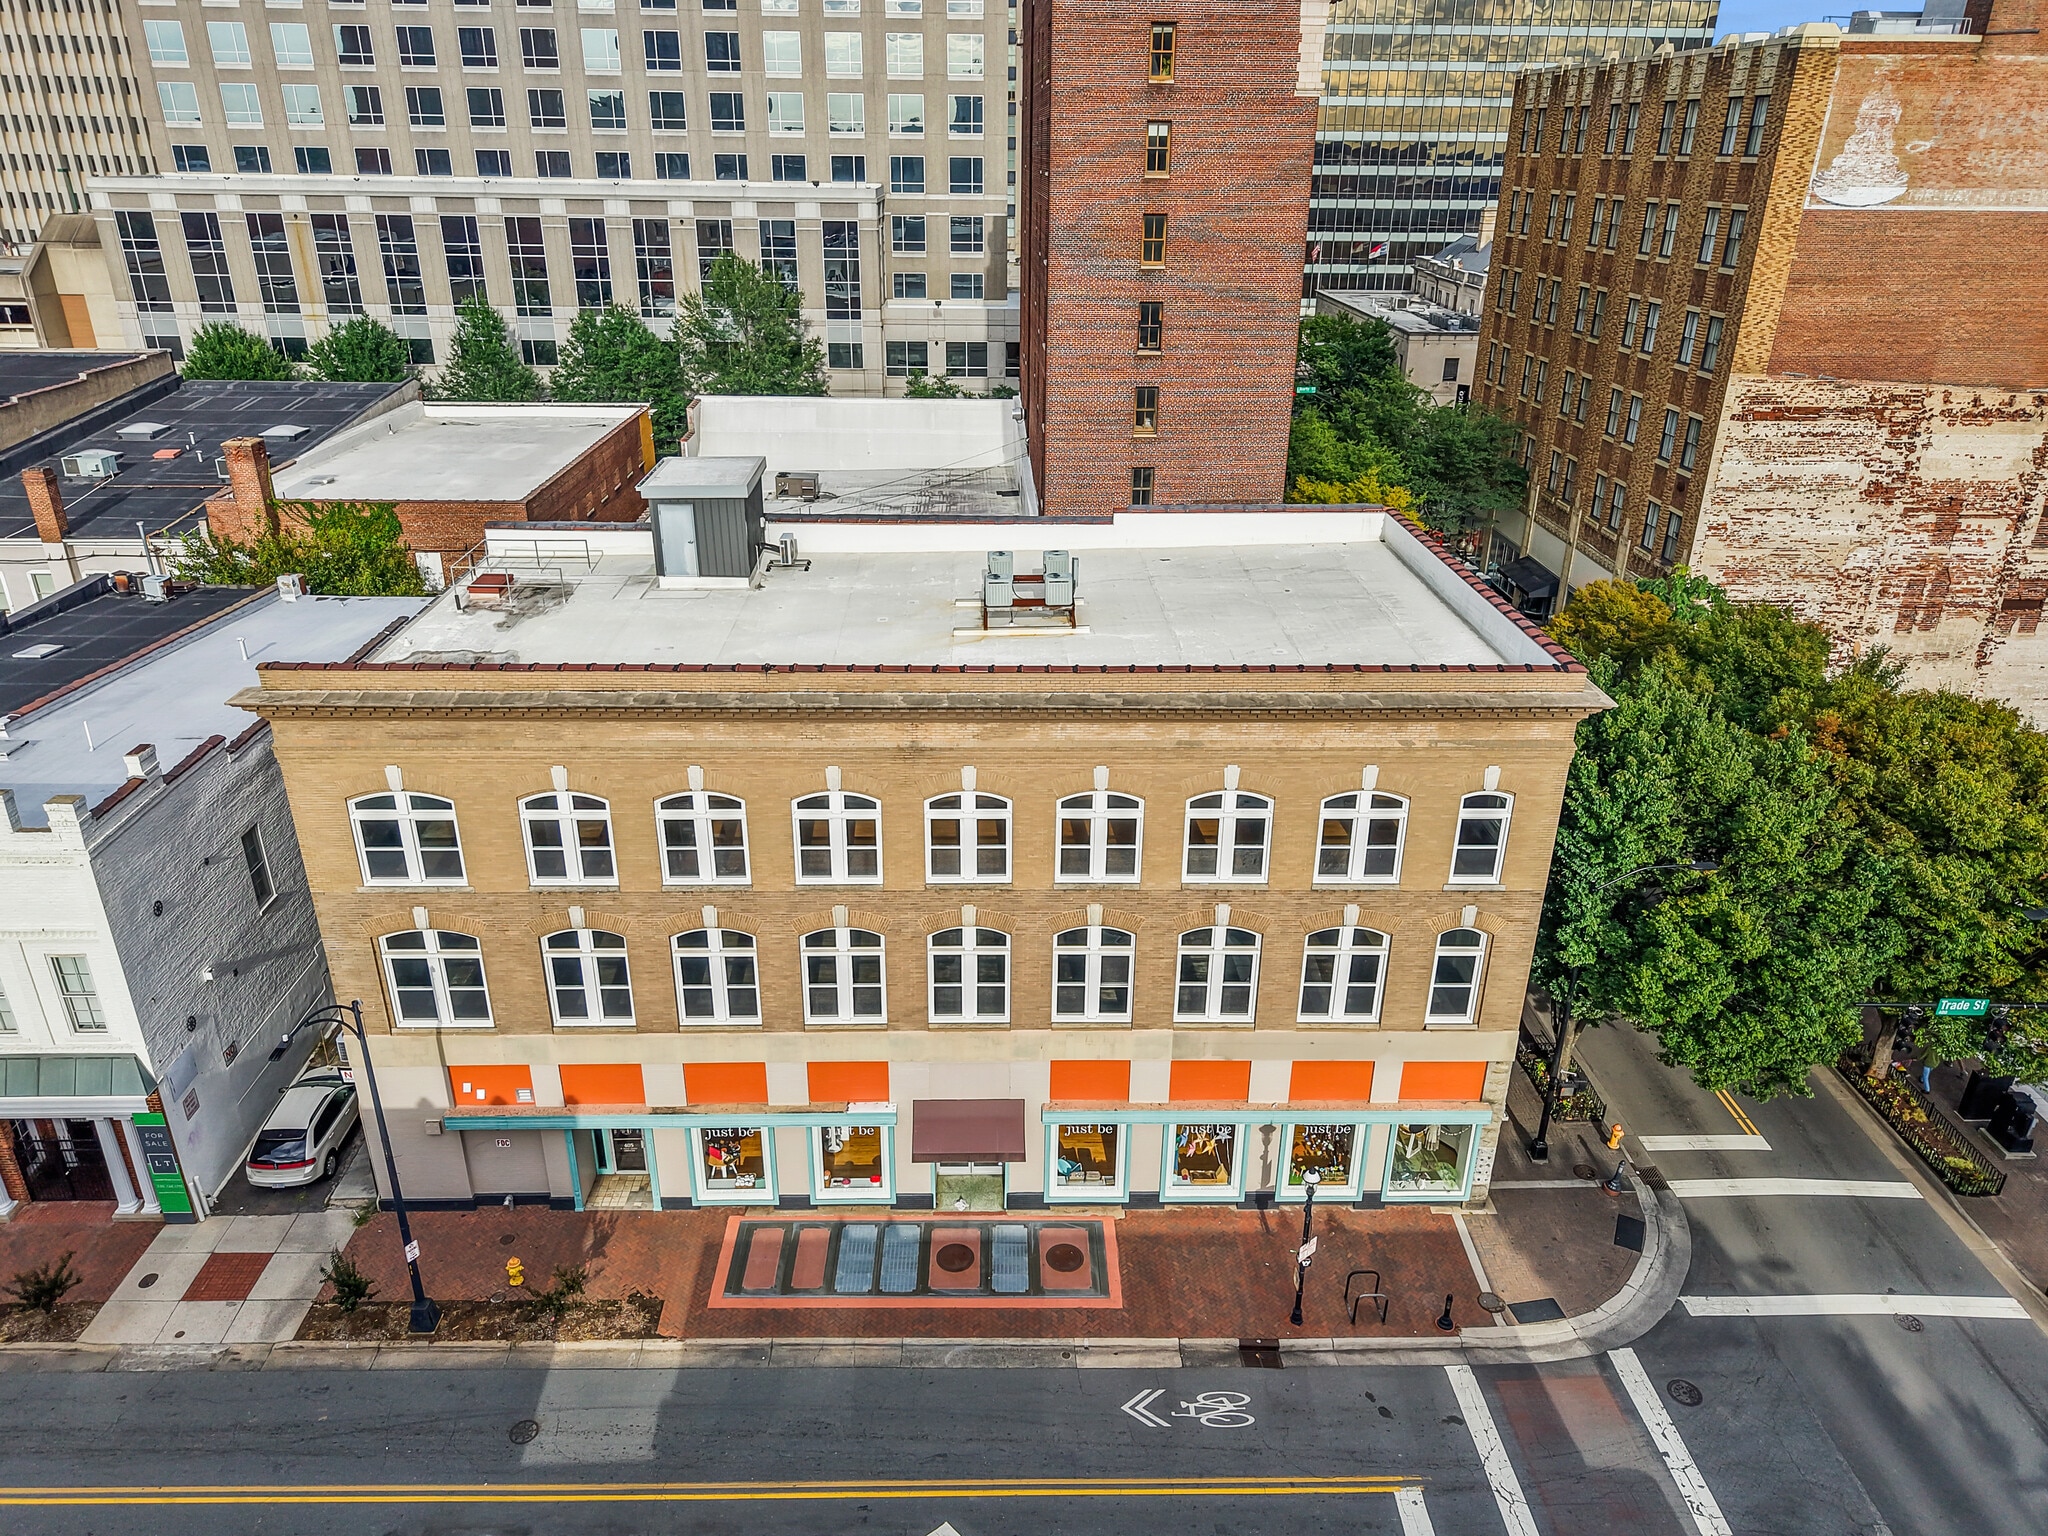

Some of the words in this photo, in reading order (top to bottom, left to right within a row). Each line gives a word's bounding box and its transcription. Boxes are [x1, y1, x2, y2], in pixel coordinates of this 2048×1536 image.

[1941, 1000, 1970, 1010] Trade
[1973, 1000, 1986, 1010] St
[705, 1127, 735, 1140] just
[738, 1127, 754, 1137] be
[859, 1126, 874, 1135] be
[1064, 1124, 1093, 1136] just
[1098, 1124, 1113, 1134] be
[1182, 1124, 1212, 1136] just
[1216, 1124, 1232, 1134] be
[1302, 1124, 1331, 1136] just
[1335, 1124, 1351, 1134] be
